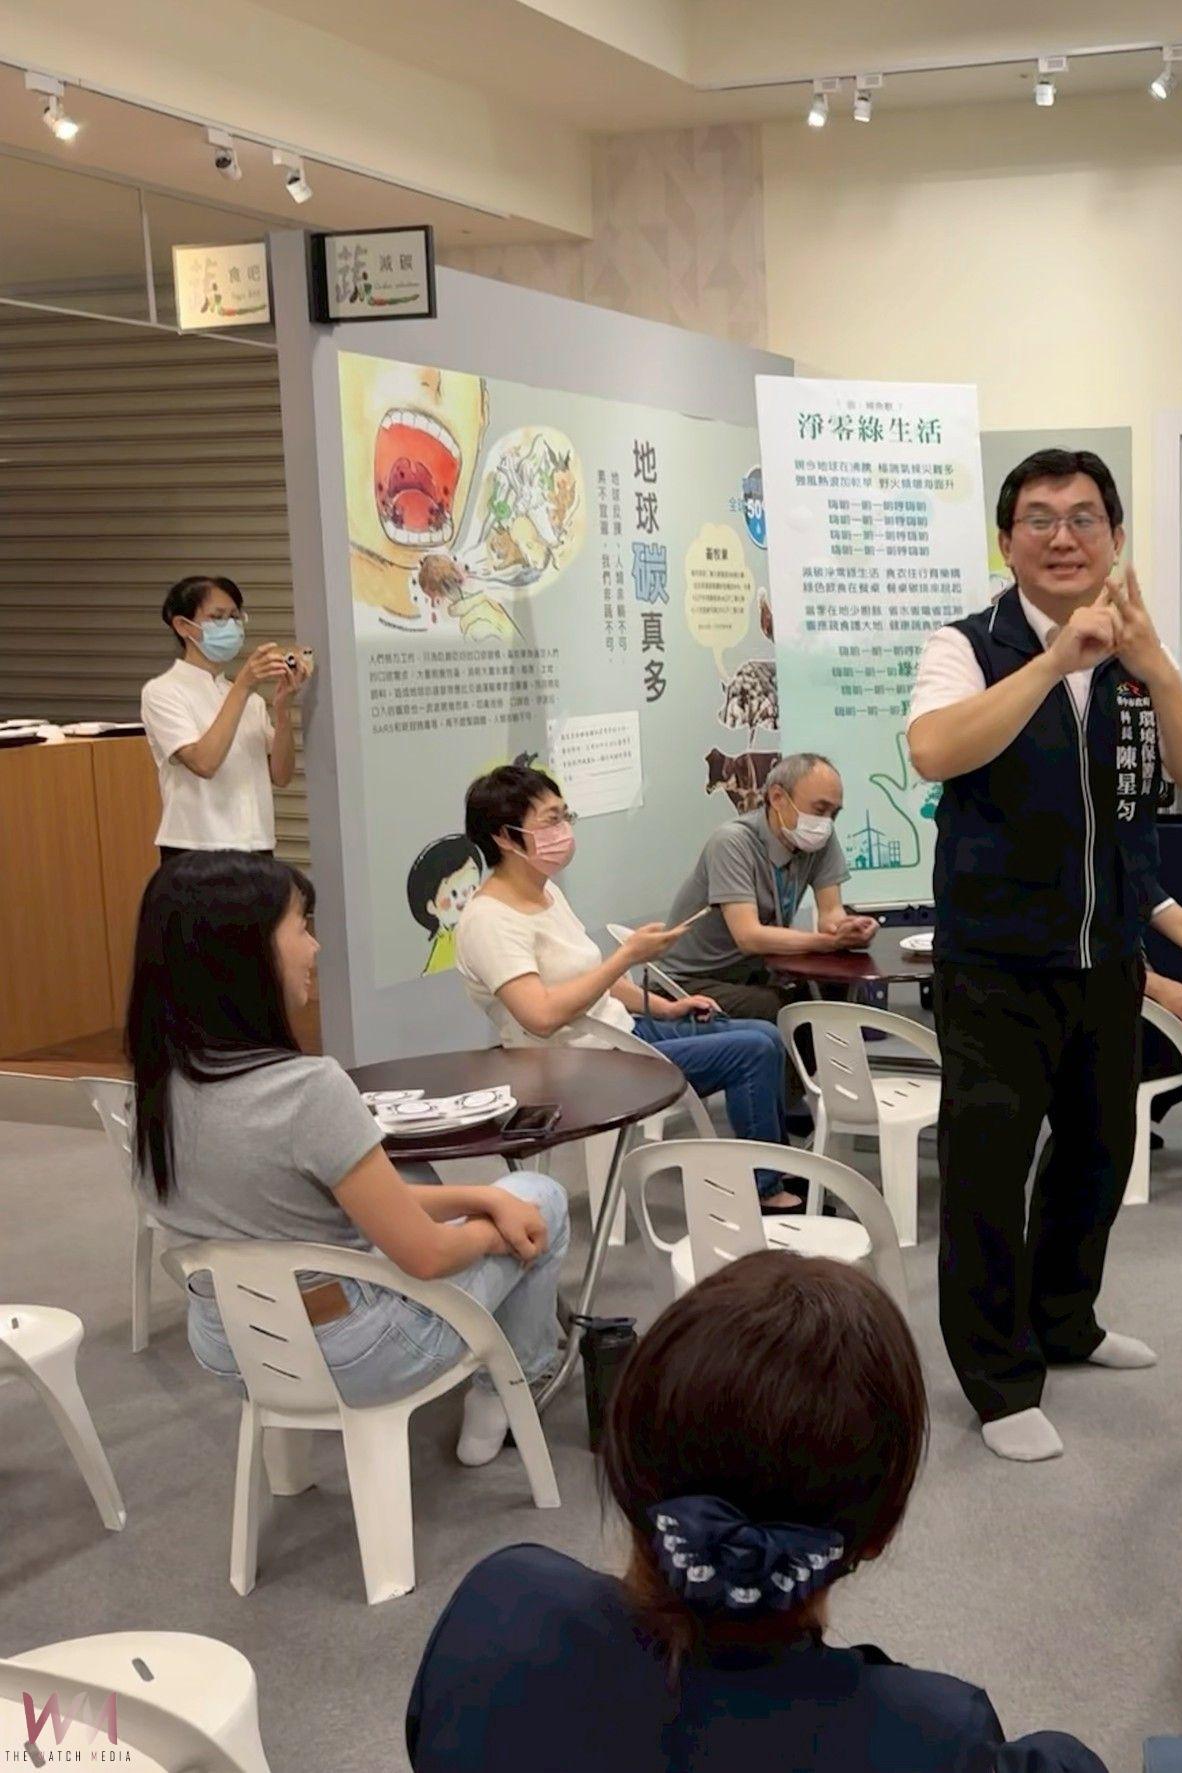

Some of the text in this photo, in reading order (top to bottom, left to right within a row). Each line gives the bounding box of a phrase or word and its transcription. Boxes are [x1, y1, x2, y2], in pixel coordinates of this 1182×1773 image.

[798, 413, 942, 445] 淨零綠生活
[631, 440, 670, 702] 地球碳真多
